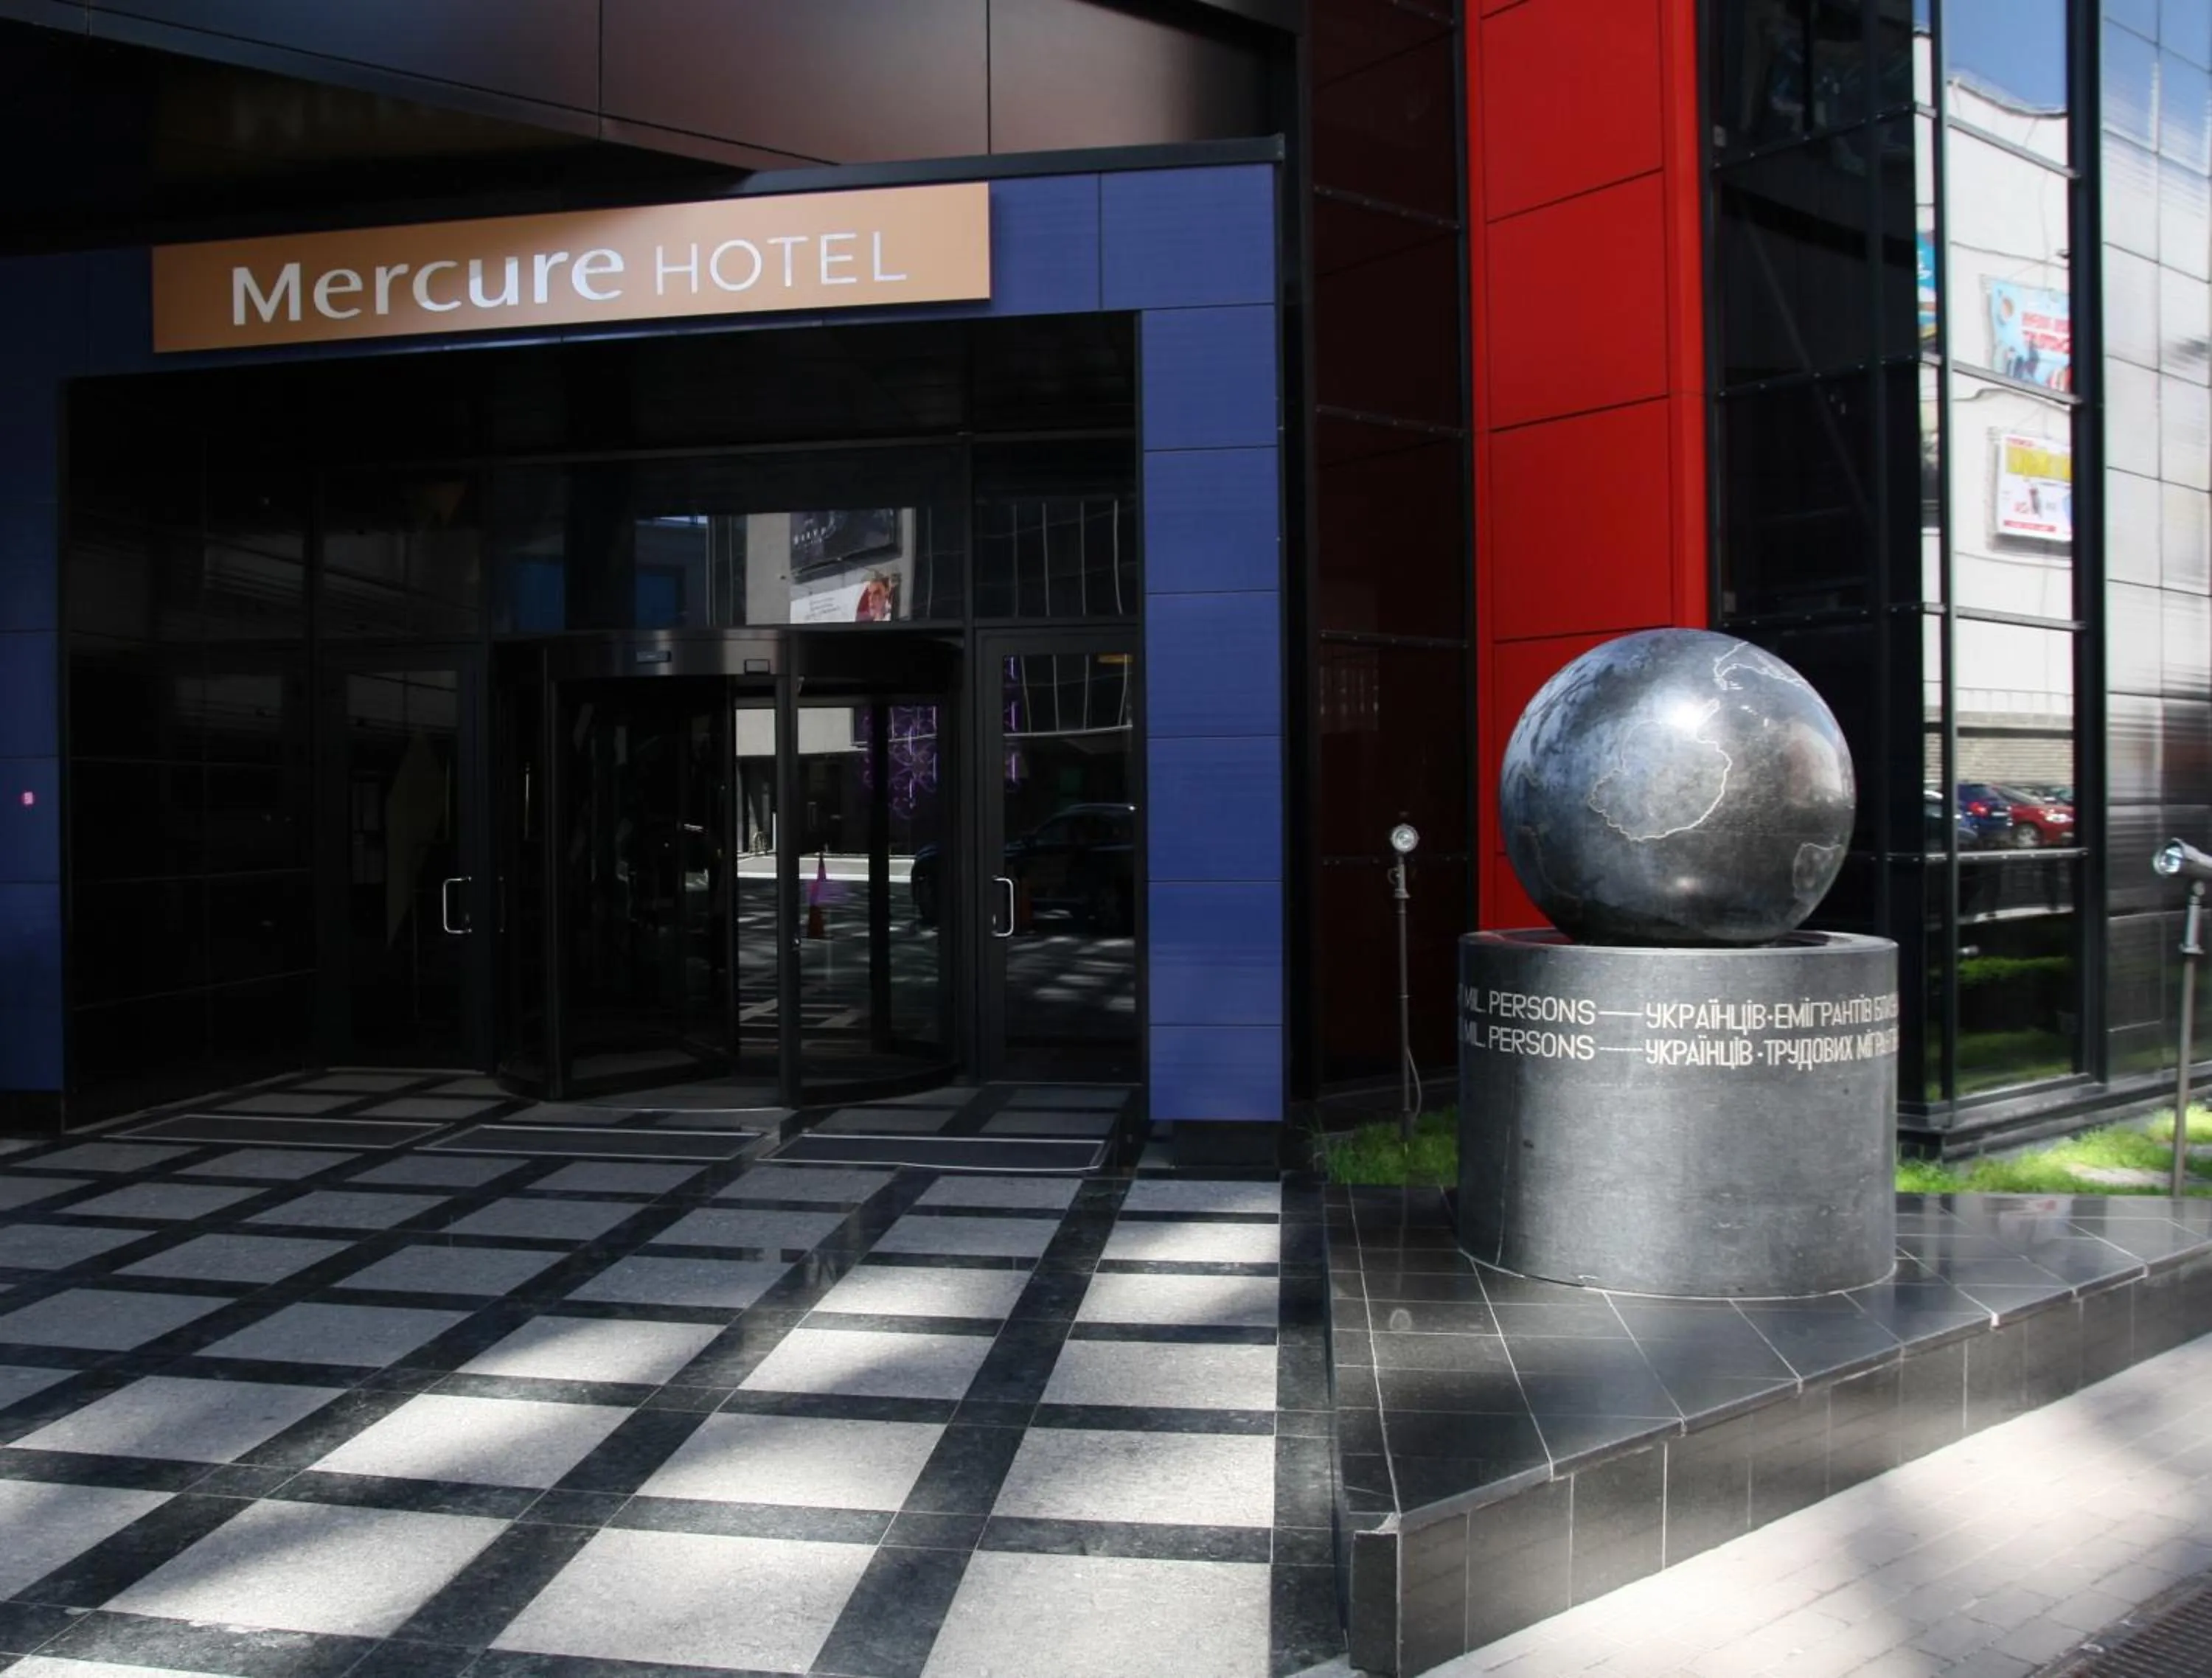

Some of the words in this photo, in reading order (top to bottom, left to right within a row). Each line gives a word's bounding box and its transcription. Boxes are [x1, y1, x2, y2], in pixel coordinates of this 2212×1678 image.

[232, 248, 625, 326] Mercure
[655, 231, 908, 295] HOTEL
[1488, 989, 1596, 1026] PERSONS
[1488, 1025, 1596, 1061] PERSONS
